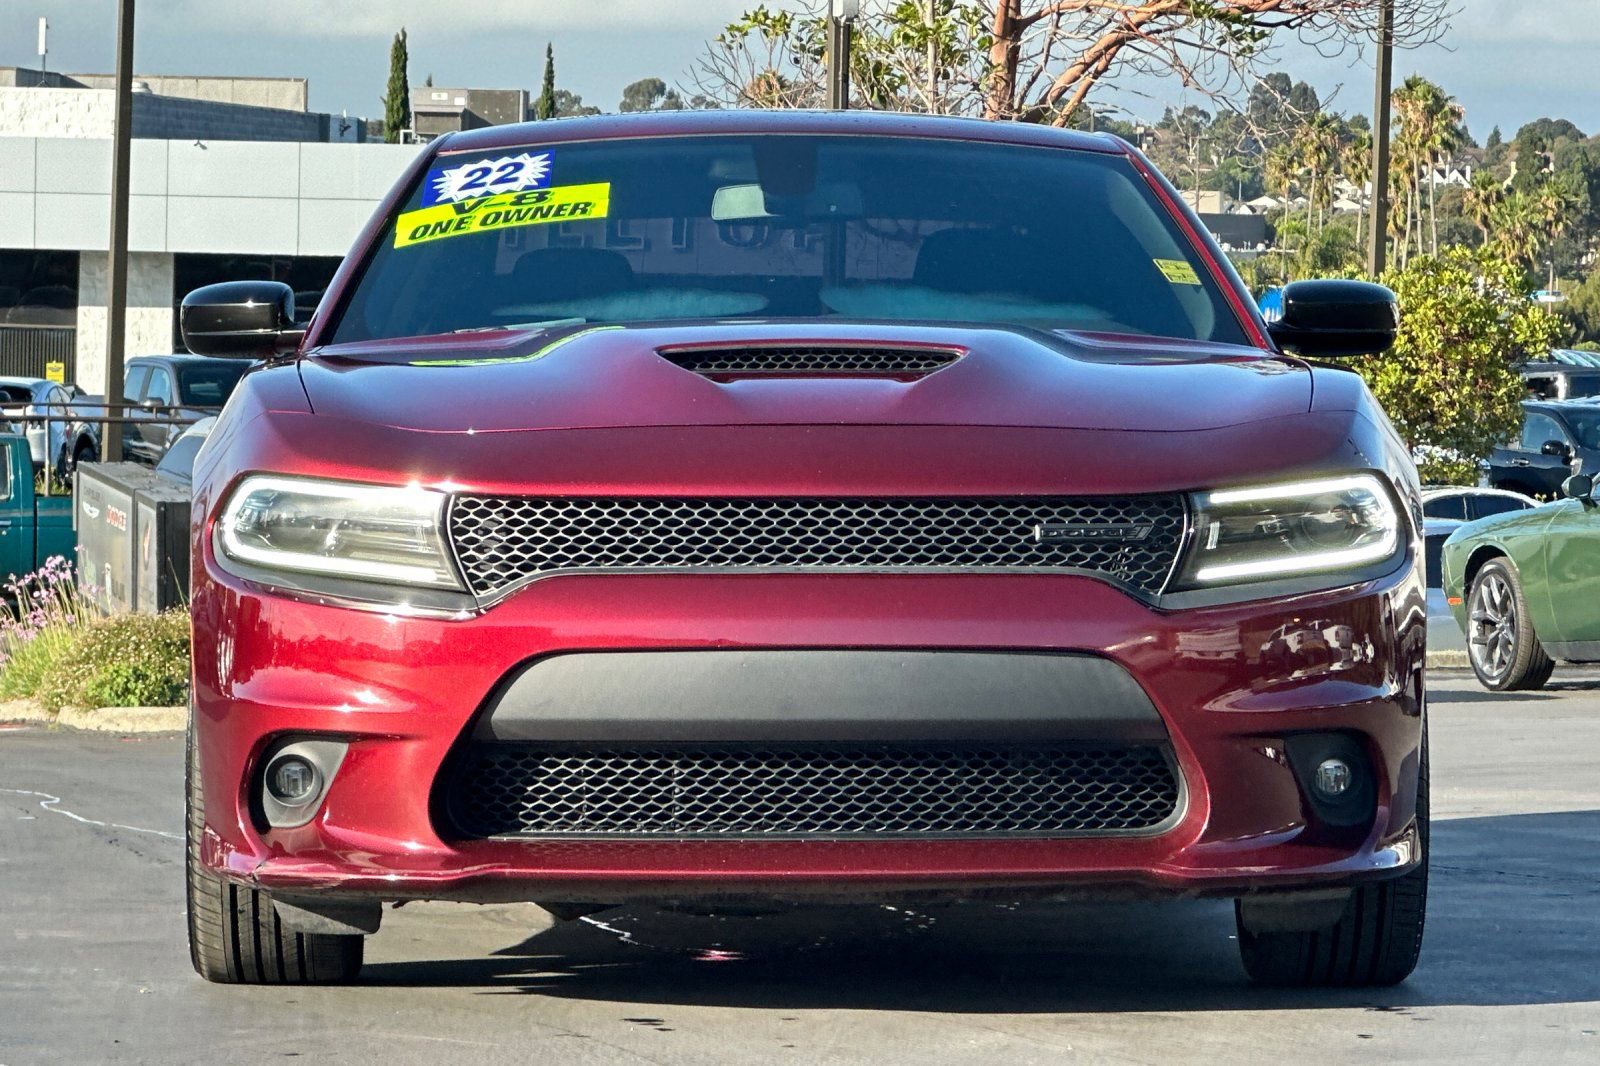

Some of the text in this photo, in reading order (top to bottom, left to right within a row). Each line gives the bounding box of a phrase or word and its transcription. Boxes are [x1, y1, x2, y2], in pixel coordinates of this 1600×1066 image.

[457, 161, 525, 192] 22
[451, 191, 553, 216] V-8
[408, 215, 476, 241] ONE
[479, 201, 595, 227] OWNER
